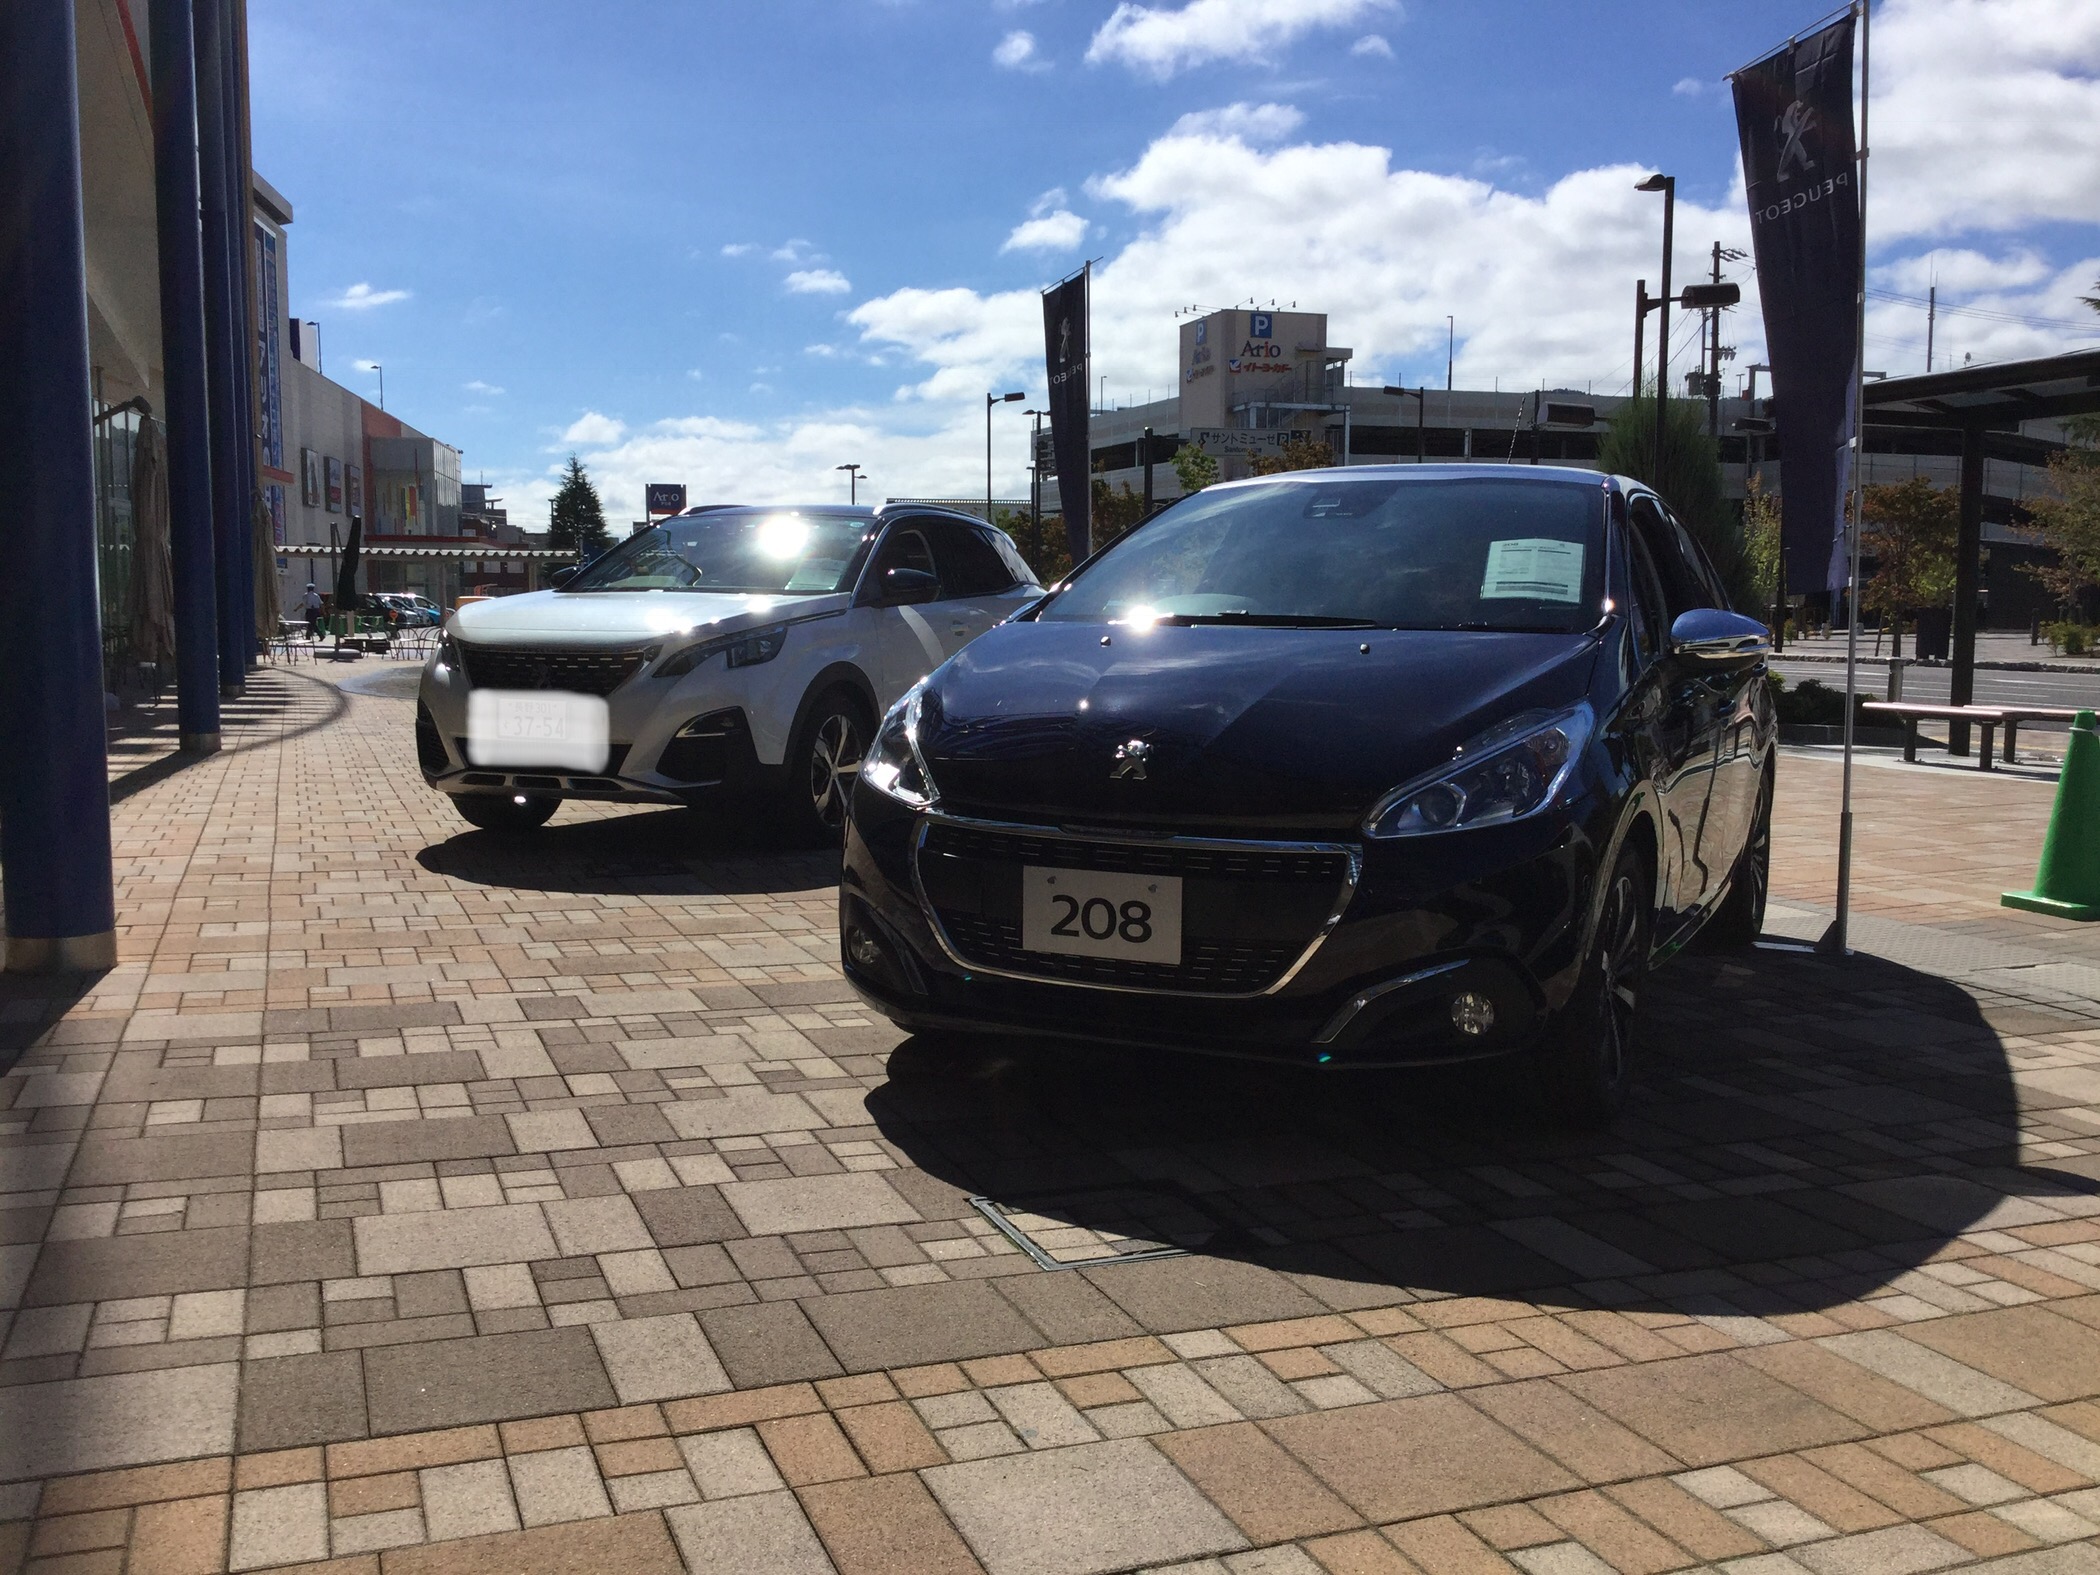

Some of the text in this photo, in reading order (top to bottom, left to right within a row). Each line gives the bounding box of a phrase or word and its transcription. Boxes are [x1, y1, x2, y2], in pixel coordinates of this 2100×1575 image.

[1254, 315, 1269, 336] P
[1240, 340, 1281, 358] Ario
[1211, 432, 1275, 446] サントミューゼ
[653, 491, 680, 502] Aro
[513, 715, 565, 738] 37-54
[1050, 894, 1153, 944] 208
